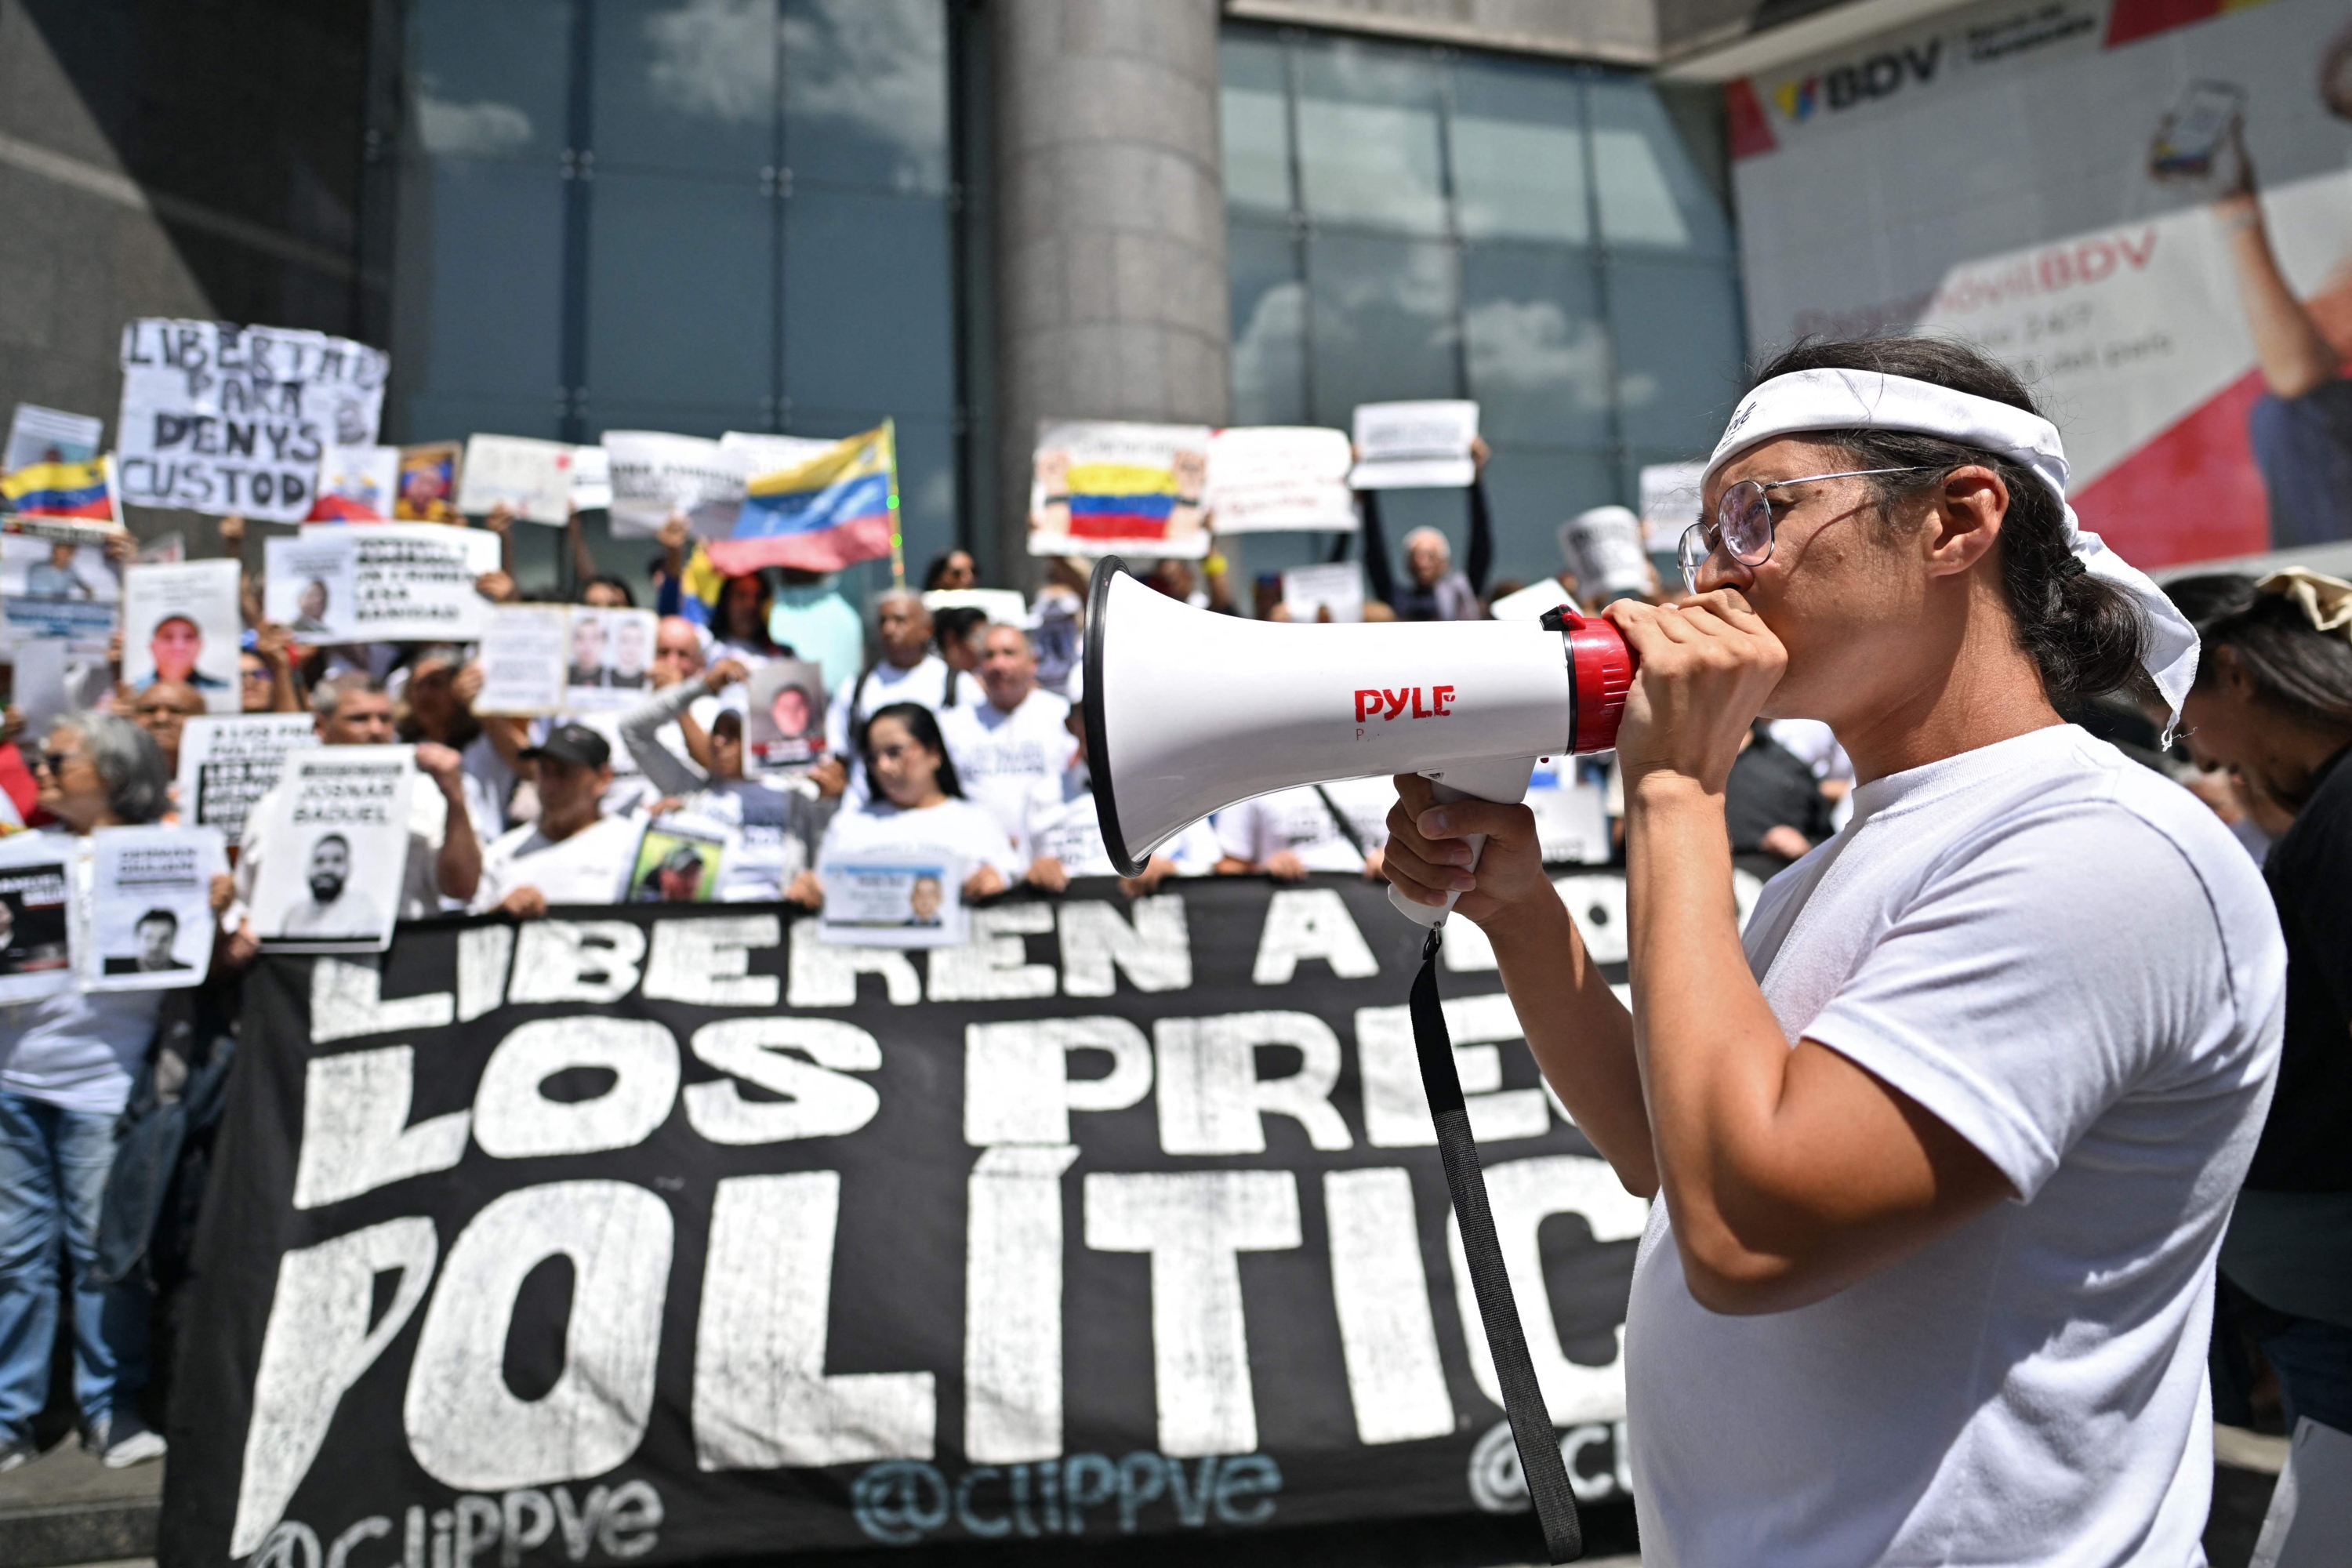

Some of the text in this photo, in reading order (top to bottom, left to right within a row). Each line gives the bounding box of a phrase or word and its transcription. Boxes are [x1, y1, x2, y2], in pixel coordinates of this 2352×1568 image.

[1827, 38, 1941, 111] BDV
[129, 323, 383, 389] LIBERTAD
[187, 366, 304, 419] PARA
[154, 413, 322, 461] DENYS
[1355, 685, 1456, 723] PYLE
[1254, 888, 1379, 984] A
[293, 990, 1577, 1210] LOS PRE
